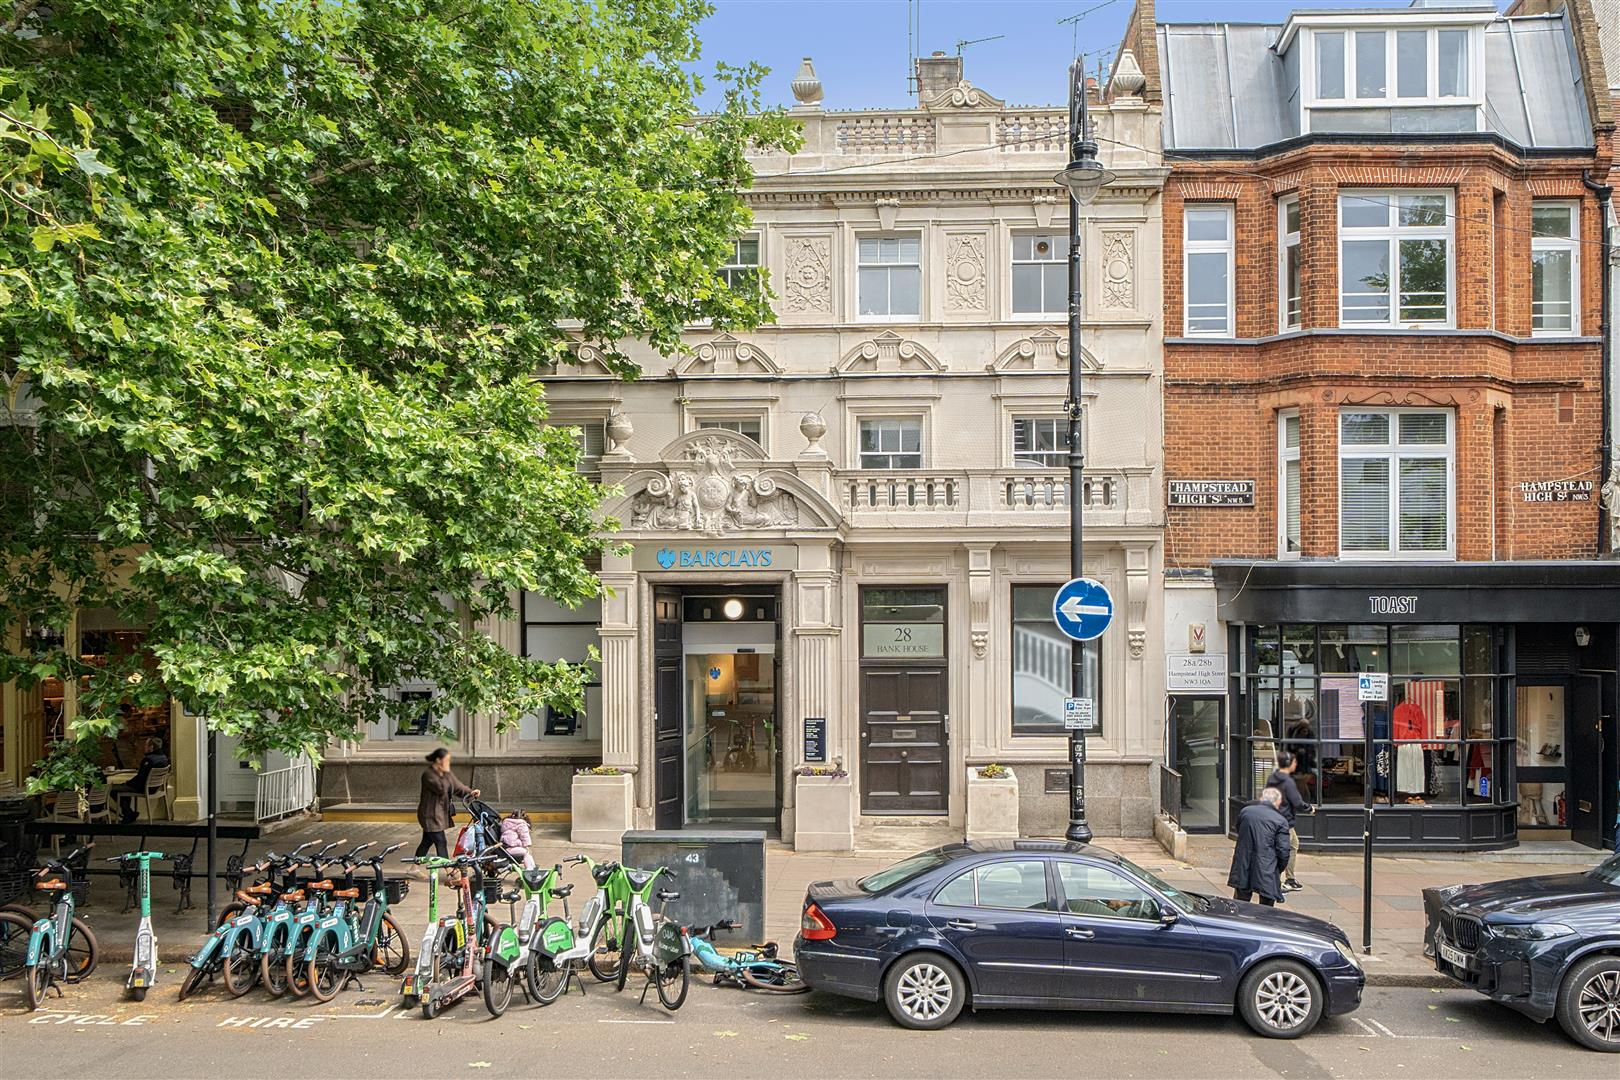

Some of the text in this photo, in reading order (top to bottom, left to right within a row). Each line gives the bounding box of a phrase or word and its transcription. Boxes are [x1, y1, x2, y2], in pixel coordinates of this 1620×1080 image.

[1175, 483, 1248, 492] HAMPSTEAD
[1520, 481, 1593, 491] HAMPSTEAD
[1178, 494, 1207, 504] HIGH
[1524, 492, 1553, 502] HIGH
[1572, 493, 1589, 501] NW3
[679, 549, 773, 568] BARCLAYS
[1368, 595, 1418, 614] TOAST
[894, 627, 912, 642] 28
[876, 645, 929, 653] BANK HOUSE
[685, 853, 700, 863] 43
[27, 1014, 326, 1029] CYCLE HIRE
